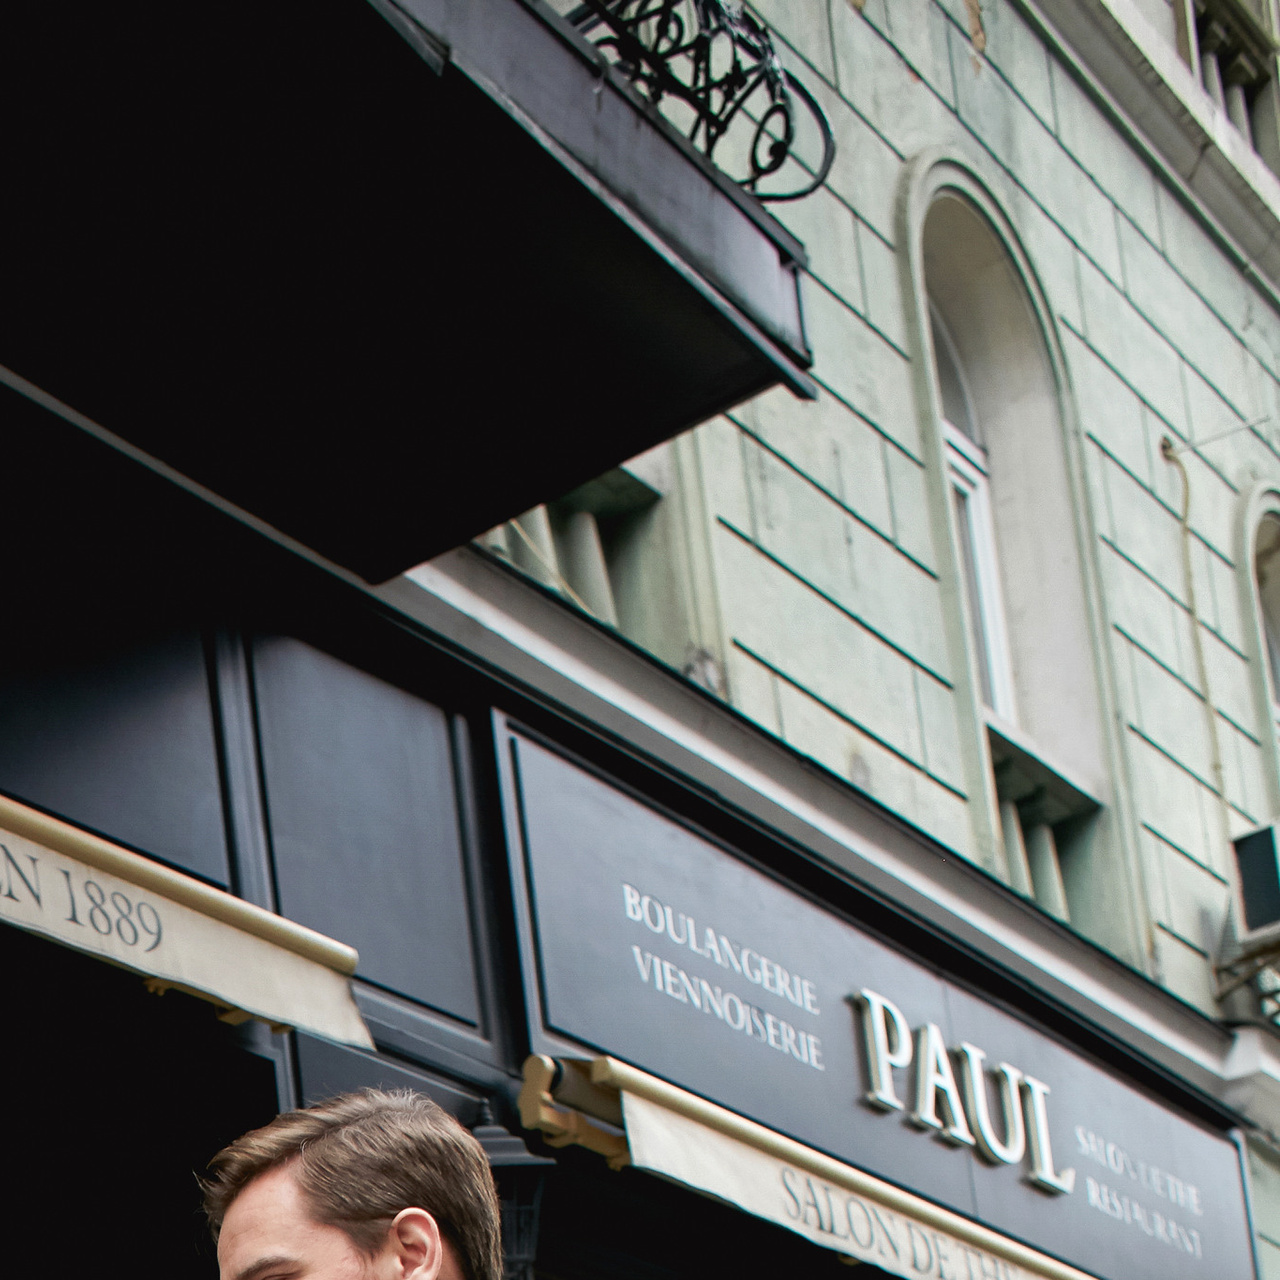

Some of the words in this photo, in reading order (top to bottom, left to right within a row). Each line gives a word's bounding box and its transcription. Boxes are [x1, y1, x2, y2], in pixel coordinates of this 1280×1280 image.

[58, 868, 163, 953] 1889
[622, 883, 821, 1016] BOULANGERIE
[631, 944, 825, 1072] VIENNOISERIE
[852, 987, 1076, 1195] PAUL
[781, 1166, 900, 1260] SALON
